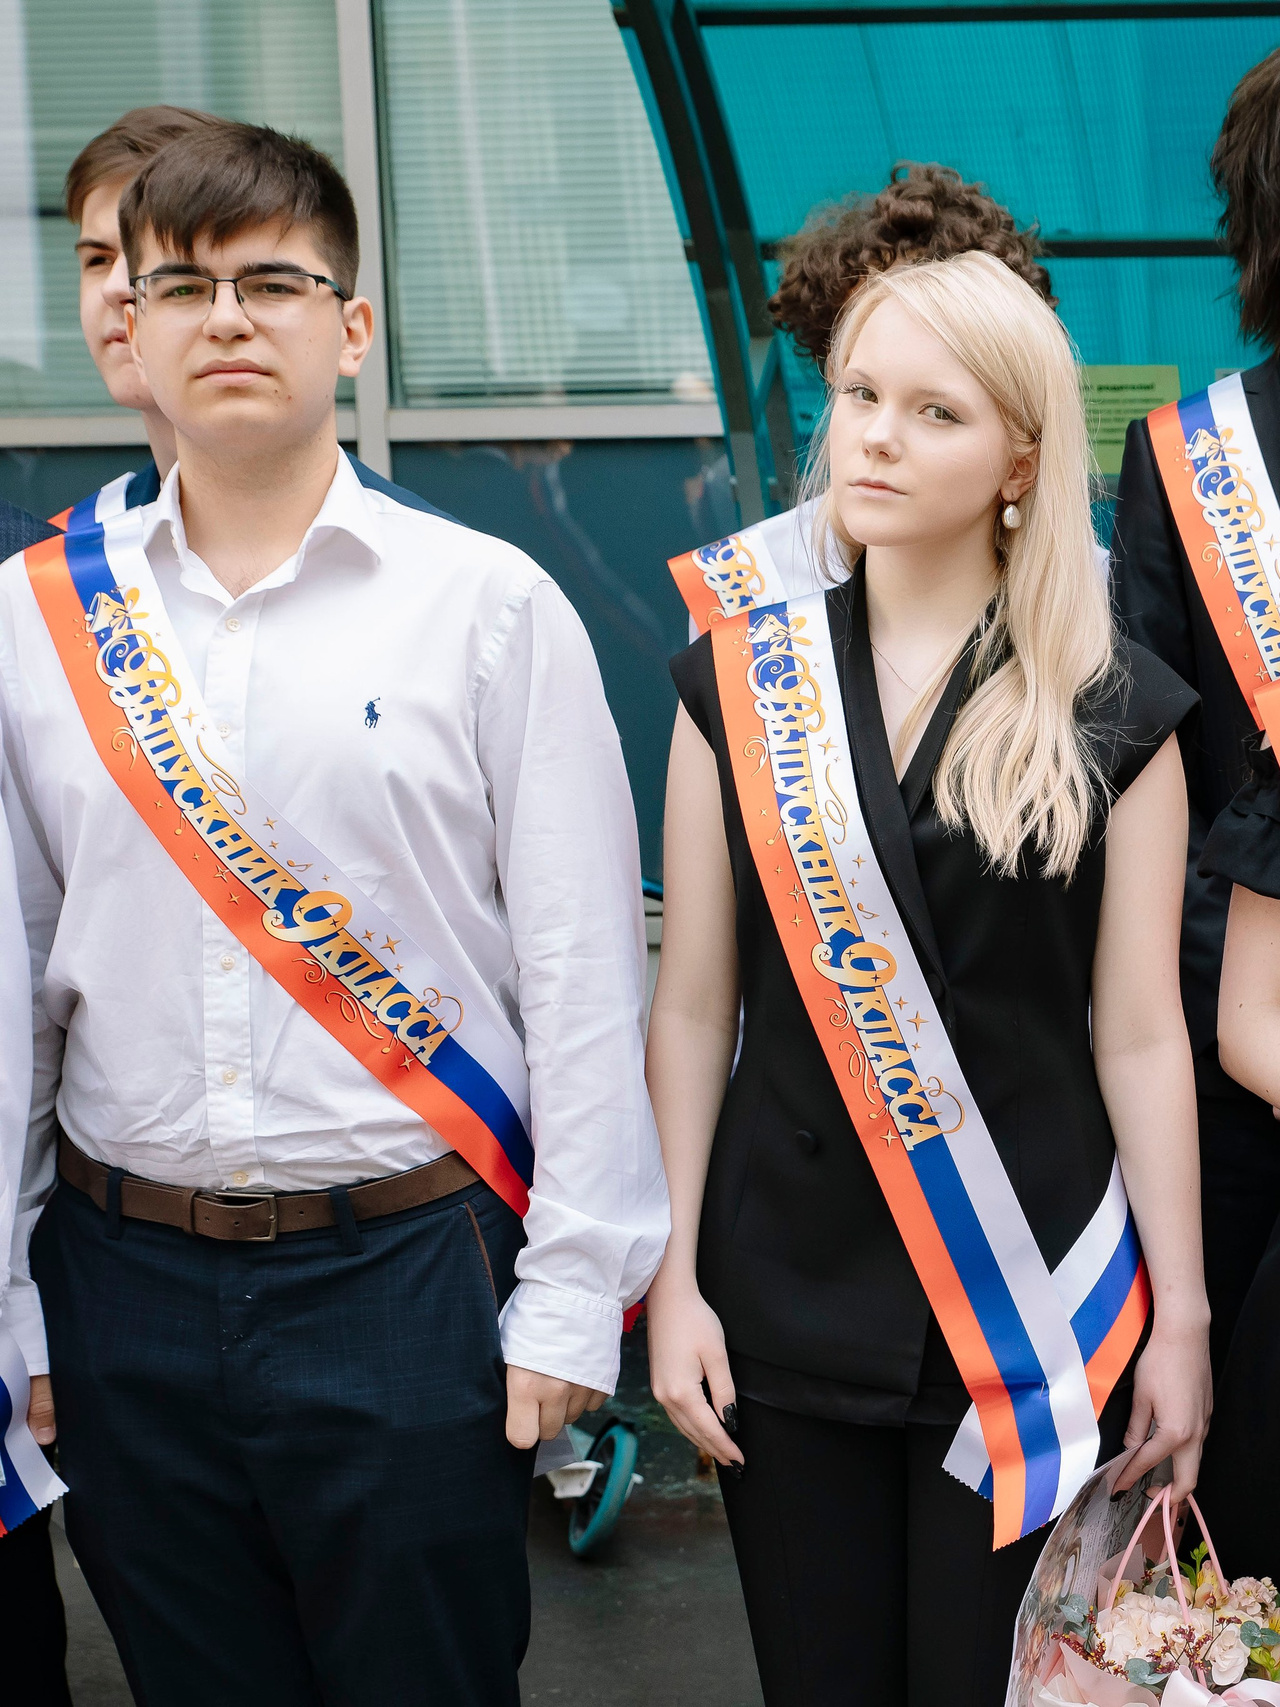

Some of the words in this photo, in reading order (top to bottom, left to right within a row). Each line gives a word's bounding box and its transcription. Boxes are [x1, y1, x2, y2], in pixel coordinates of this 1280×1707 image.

[95, 629, 304, 909] ВЫПУСКНИК
[262, 891, 352, 943] 9
[307, 927, 450, 1067] КЛАССА
[747, 650, 862, 943] ВЫПУСКНИК
[811, 942, 897, 987] 9
[842, 987, 942, 1151] КЛАССА
